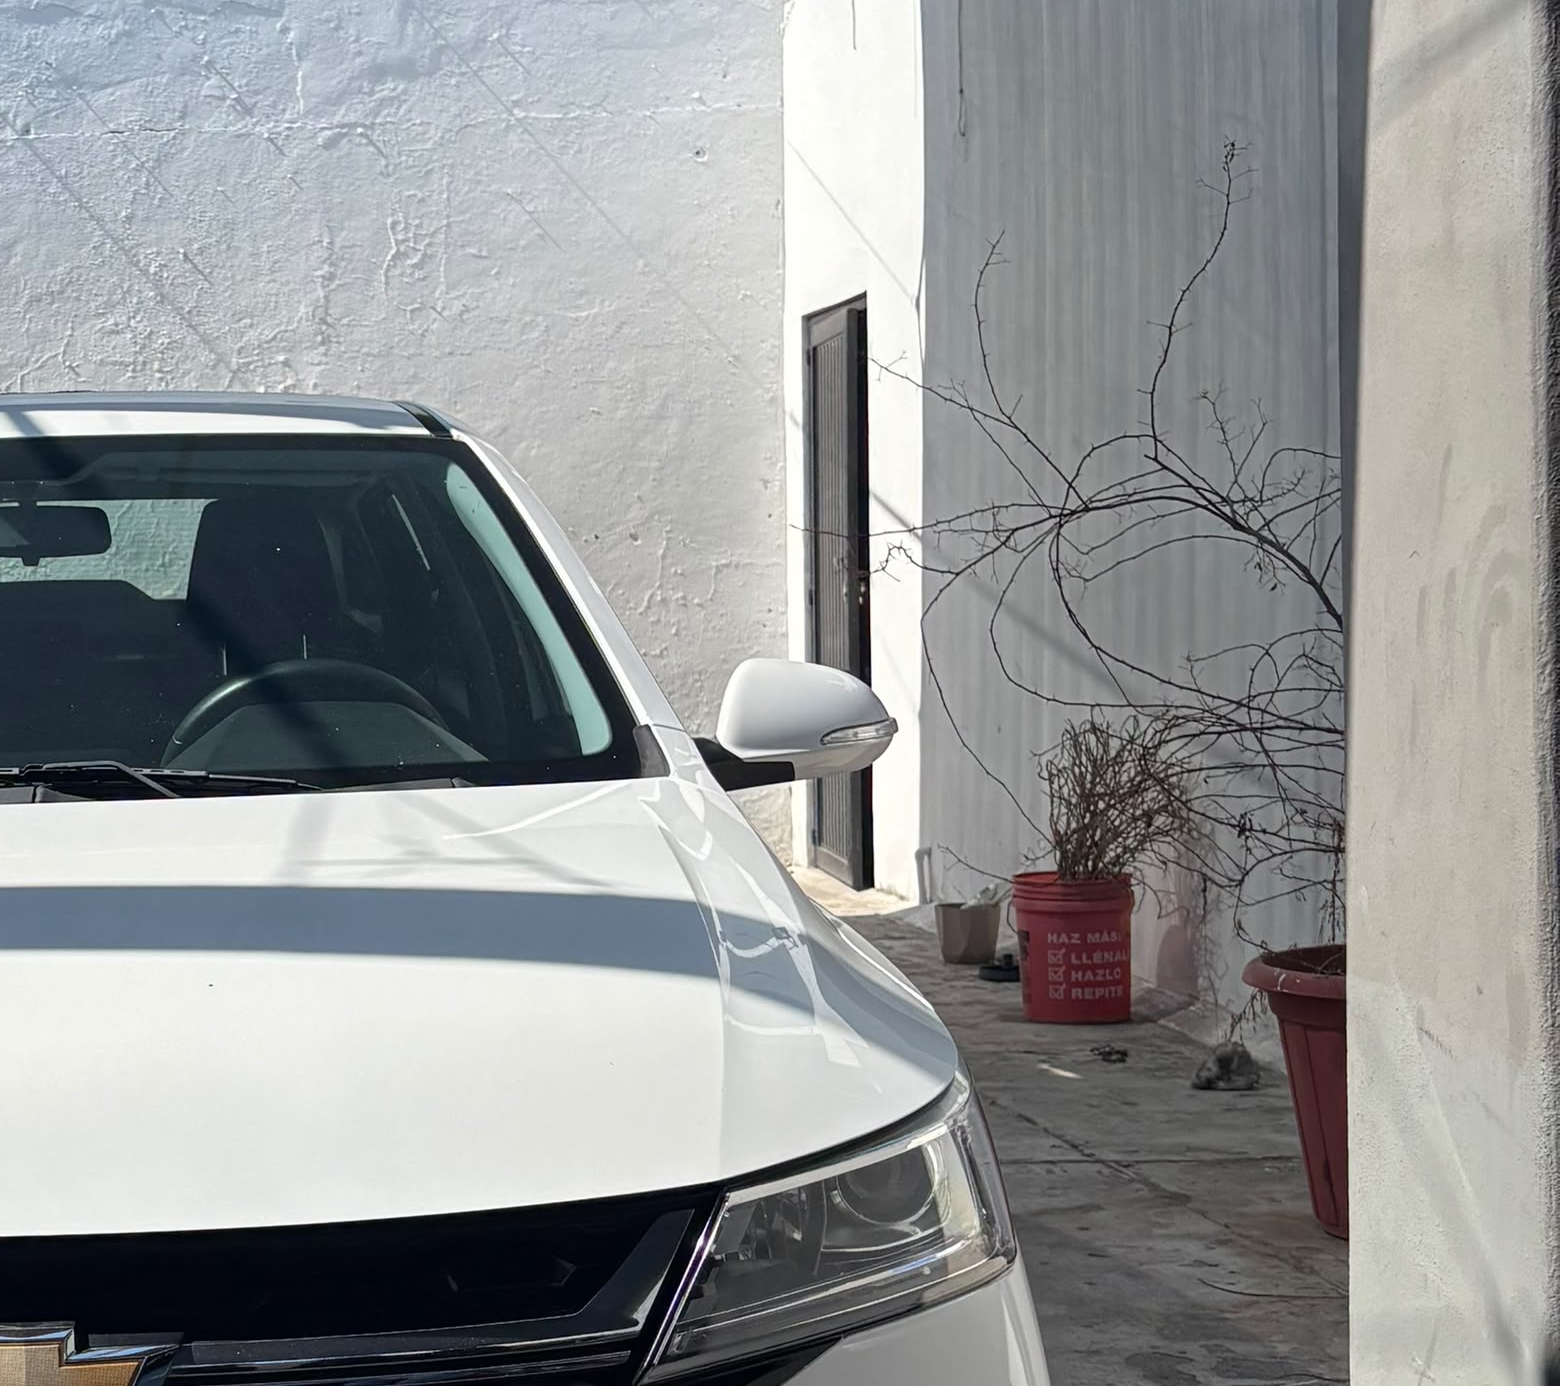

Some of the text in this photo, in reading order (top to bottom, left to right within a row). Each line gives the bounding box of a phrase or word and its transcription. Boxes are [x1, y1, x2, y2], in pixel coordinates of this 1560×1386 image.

[1047, 932, 1081, 944] HAZ
[1071, 949, 1129, 963] LLÉNAL
[1071, 967, 1121, 982] HAZLO
[1071, 985, 1124, 1000] REPITE
